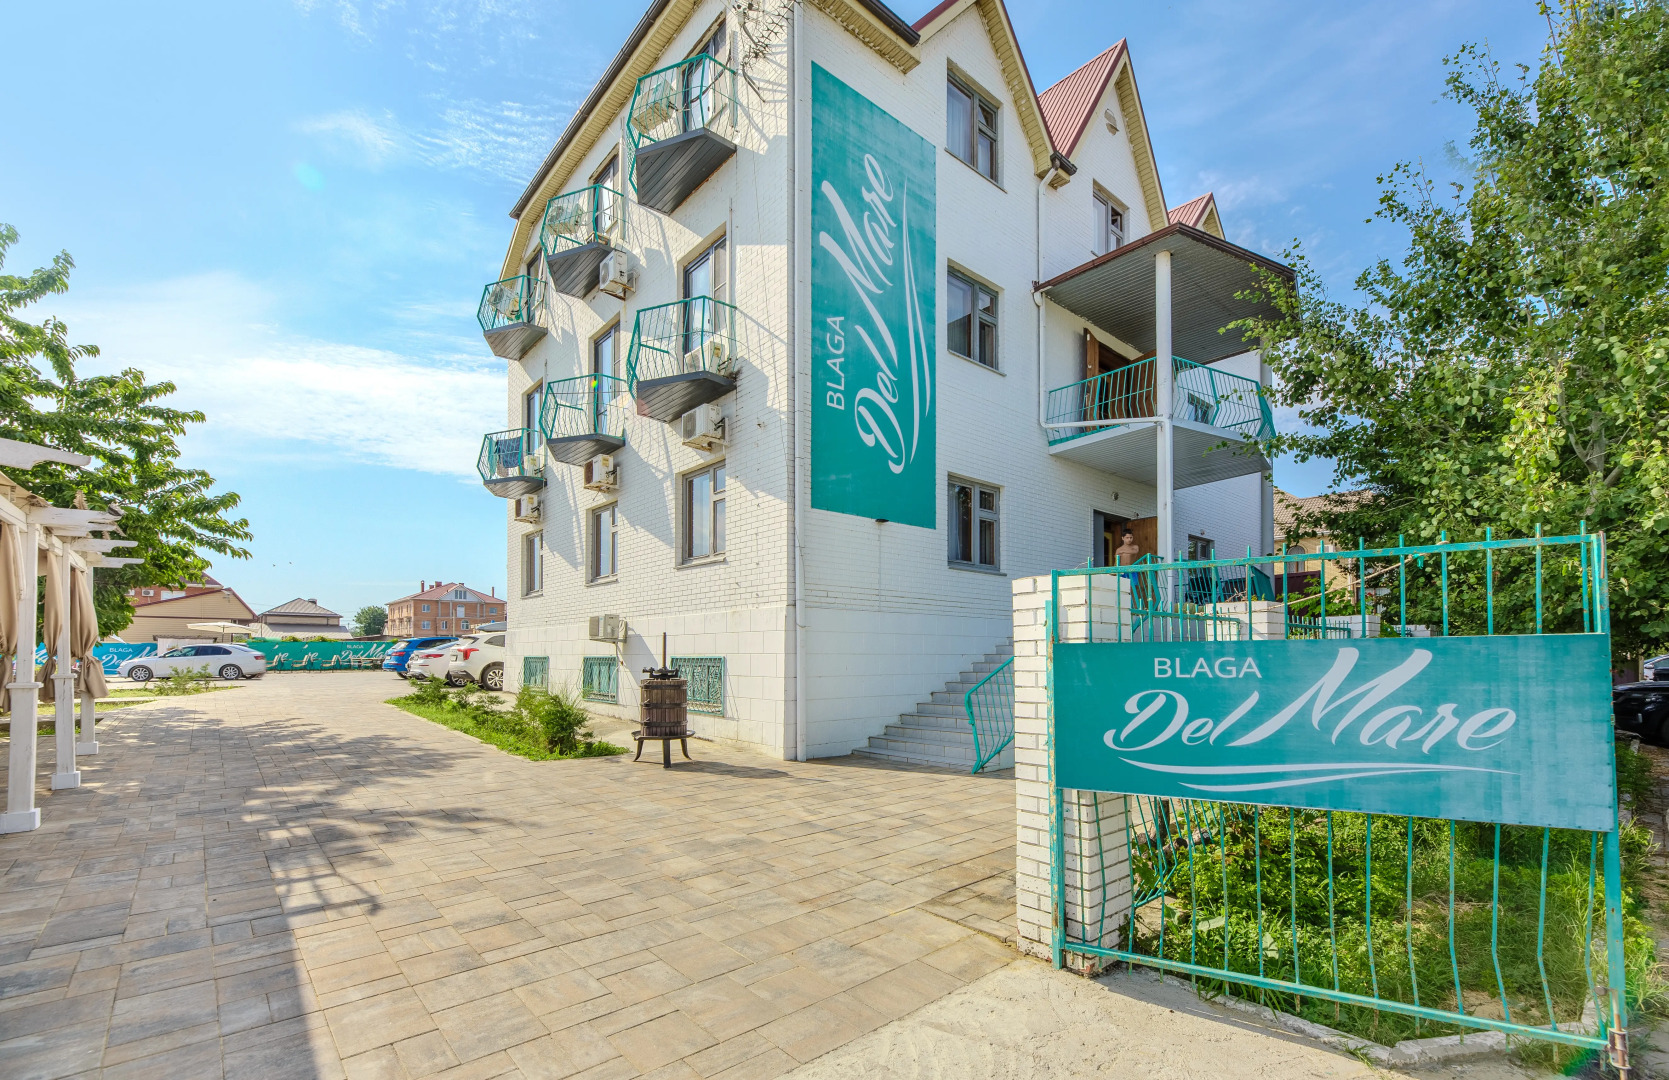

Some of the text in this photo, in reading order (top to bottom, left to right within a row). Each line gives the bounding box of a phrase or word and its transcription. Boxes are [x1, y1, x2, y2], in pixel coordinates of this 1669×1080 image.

[820, 154, 905, 474] Del Mare
[826, 316, 845, 410] BLAGA
[362, 643, 387, 659] Ma
[1154, 657, 1262, 680] BLAGA
[1103, 647, 1517, 754] Del Mare
